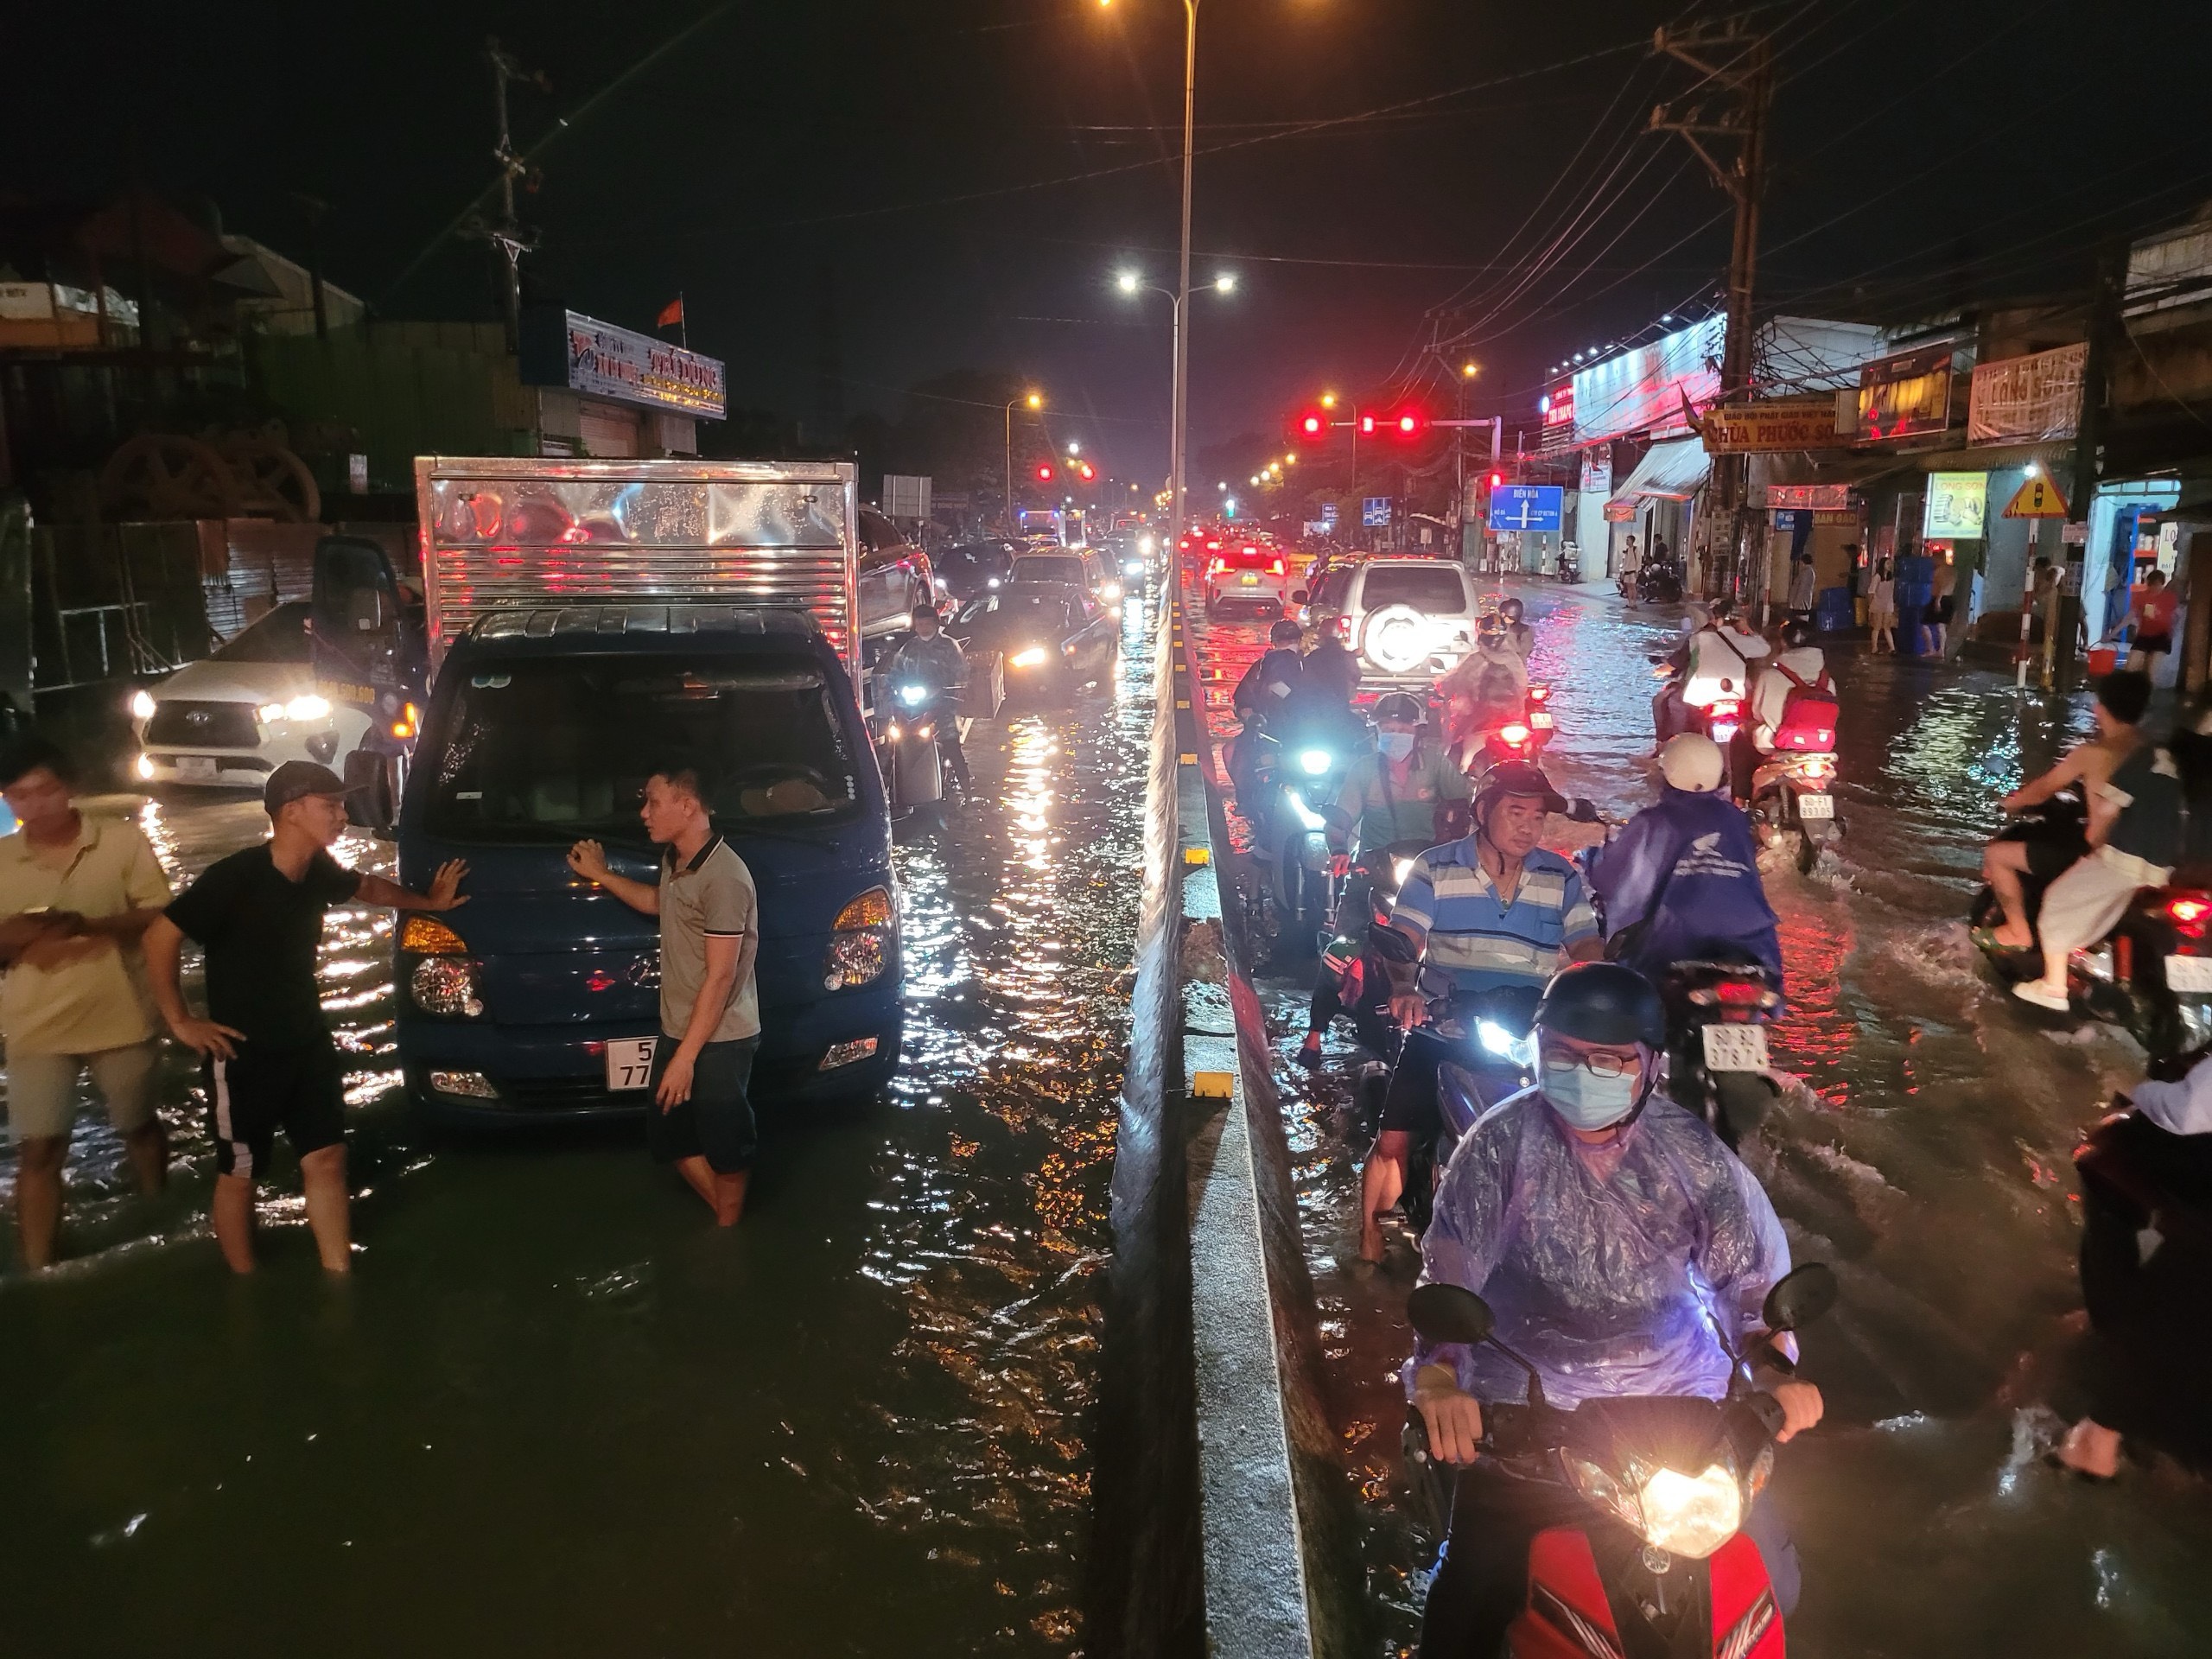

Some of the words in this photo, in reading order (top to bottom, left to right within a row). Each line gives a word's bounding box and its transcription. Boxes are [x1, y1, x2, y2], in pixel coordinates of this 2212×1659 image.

[1935, 481, 1963, 491] LONG
[1513, 488, 1527, 499] BIÊN
[1527, 488, 1539, 499] HÒA
